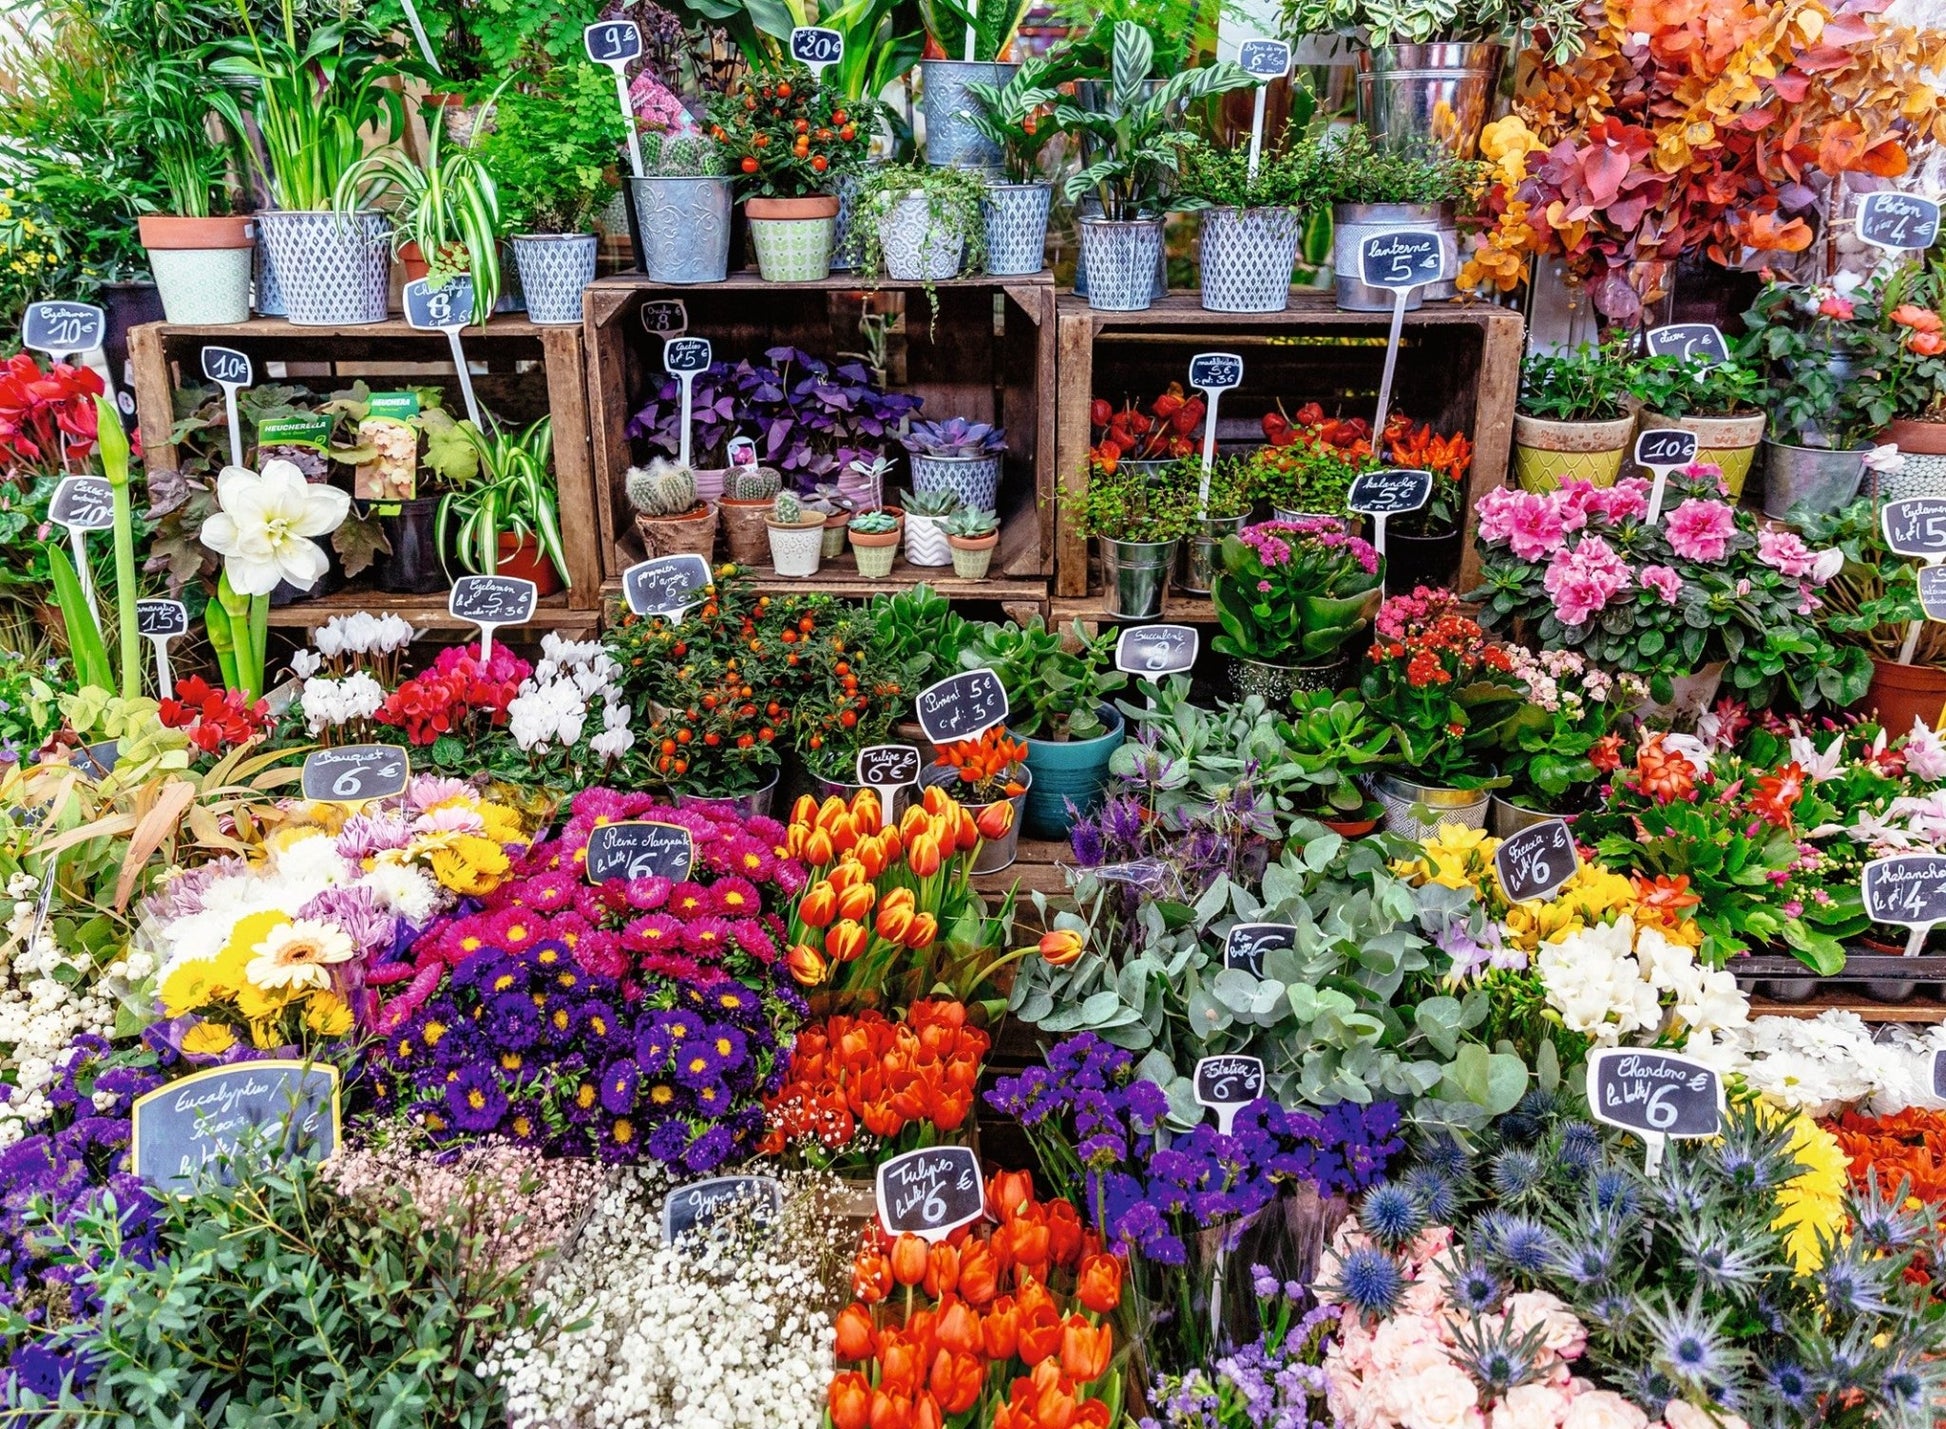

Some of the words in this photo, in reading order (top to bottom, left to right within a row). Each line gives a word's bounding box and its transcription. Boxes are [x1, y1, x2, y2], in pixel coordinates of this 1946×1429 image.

[1874, 195, 1922, 218] Coton
[1890, 215, 1910, 244] 4
[1369, 237, 1431, 258] lanterne
[1384, 255, 1412, 281] 5
[426, 293, 451, 319] 8
[682, 350, 696, 367] 5
[1923, 517, 1946, 547] 5
[469, 578, 516, 598] Cyclamen
[482, 592, 503, 608] 5
[314, 751, 385, 777] Bouquet
[332, 766, 371, 796] 6
[603, 827, 638, 850] Reine
[1532, 847, 1551, 885] 6
[1902, 880, 1928, 918] 4
[1213, 1076, 1238, 1099] 6
[1646, 1084, 1678, 1129] 6
[1686, 1072, 1708, 1092] €
[922, 1180, 947, 1223] 6
